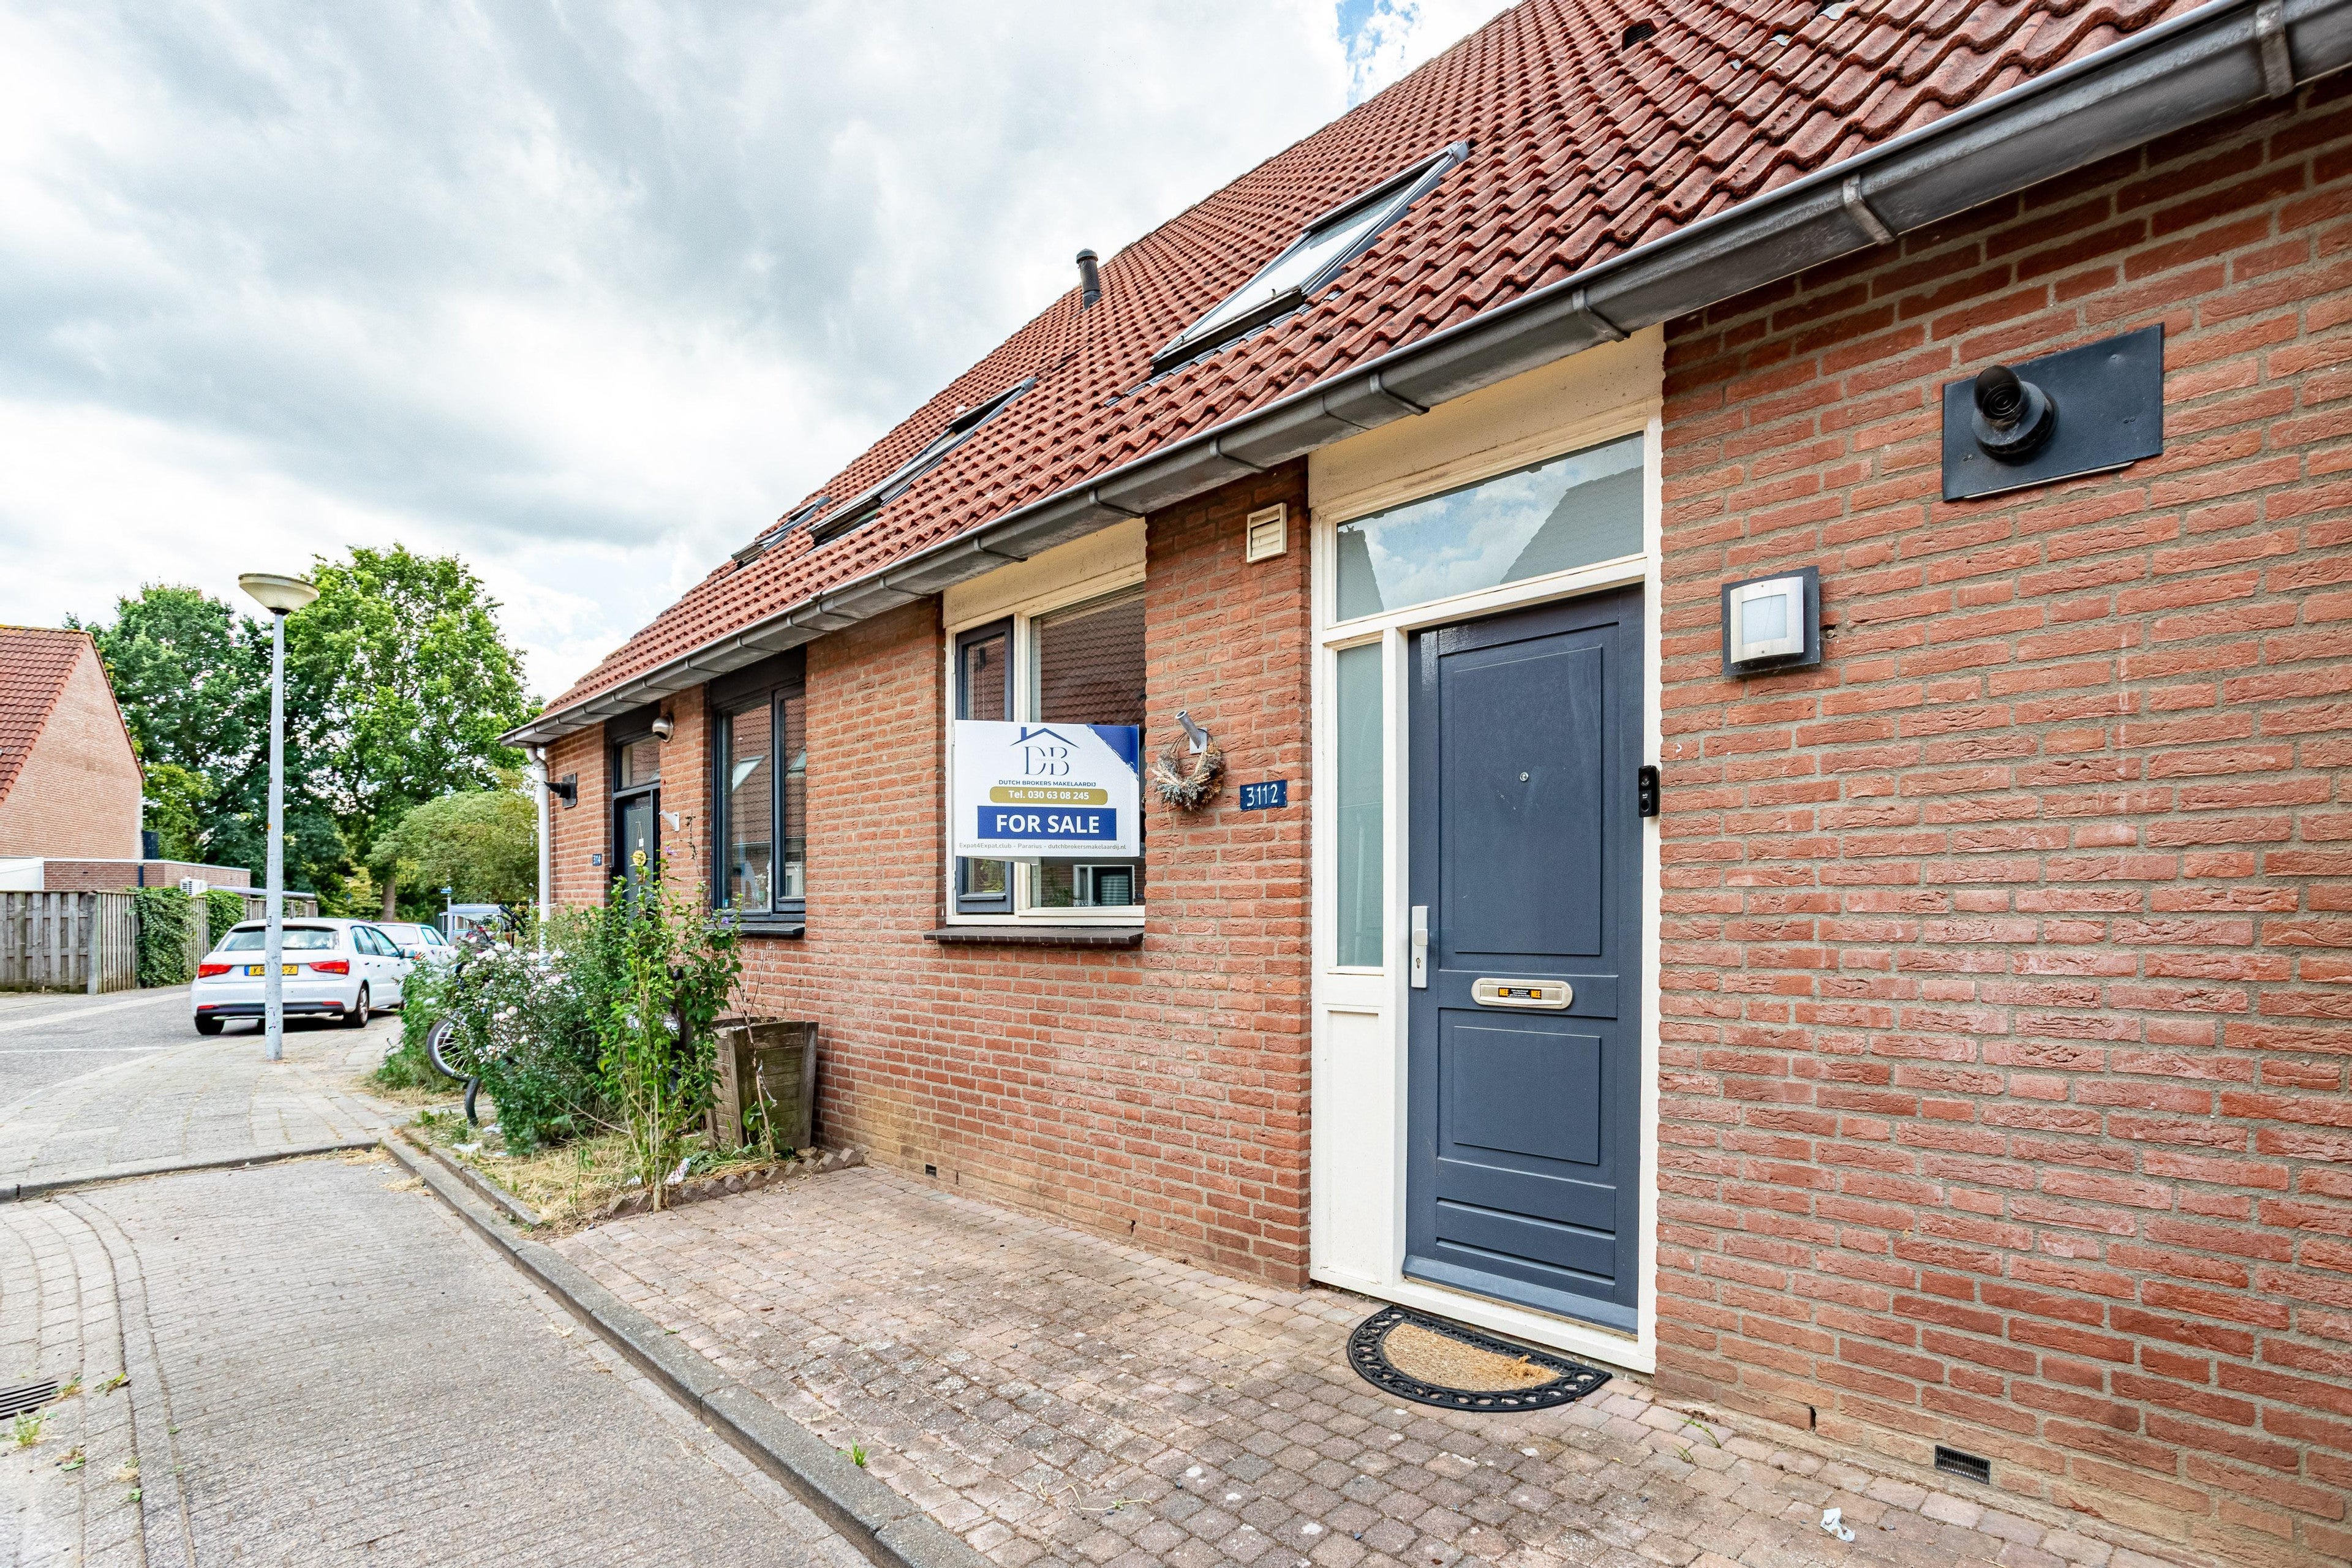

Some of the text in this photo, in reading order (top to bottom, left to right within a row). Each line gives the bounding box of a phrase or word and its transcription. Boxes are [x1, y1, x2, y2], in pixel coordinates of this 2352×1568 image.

[1024, 745, 1069, 776] DB
[1008, 790, 1025, 799] Tel.
[1246, 783, 1278, 807] 3112
[996, 814, 1099, 834] FOR SALE
